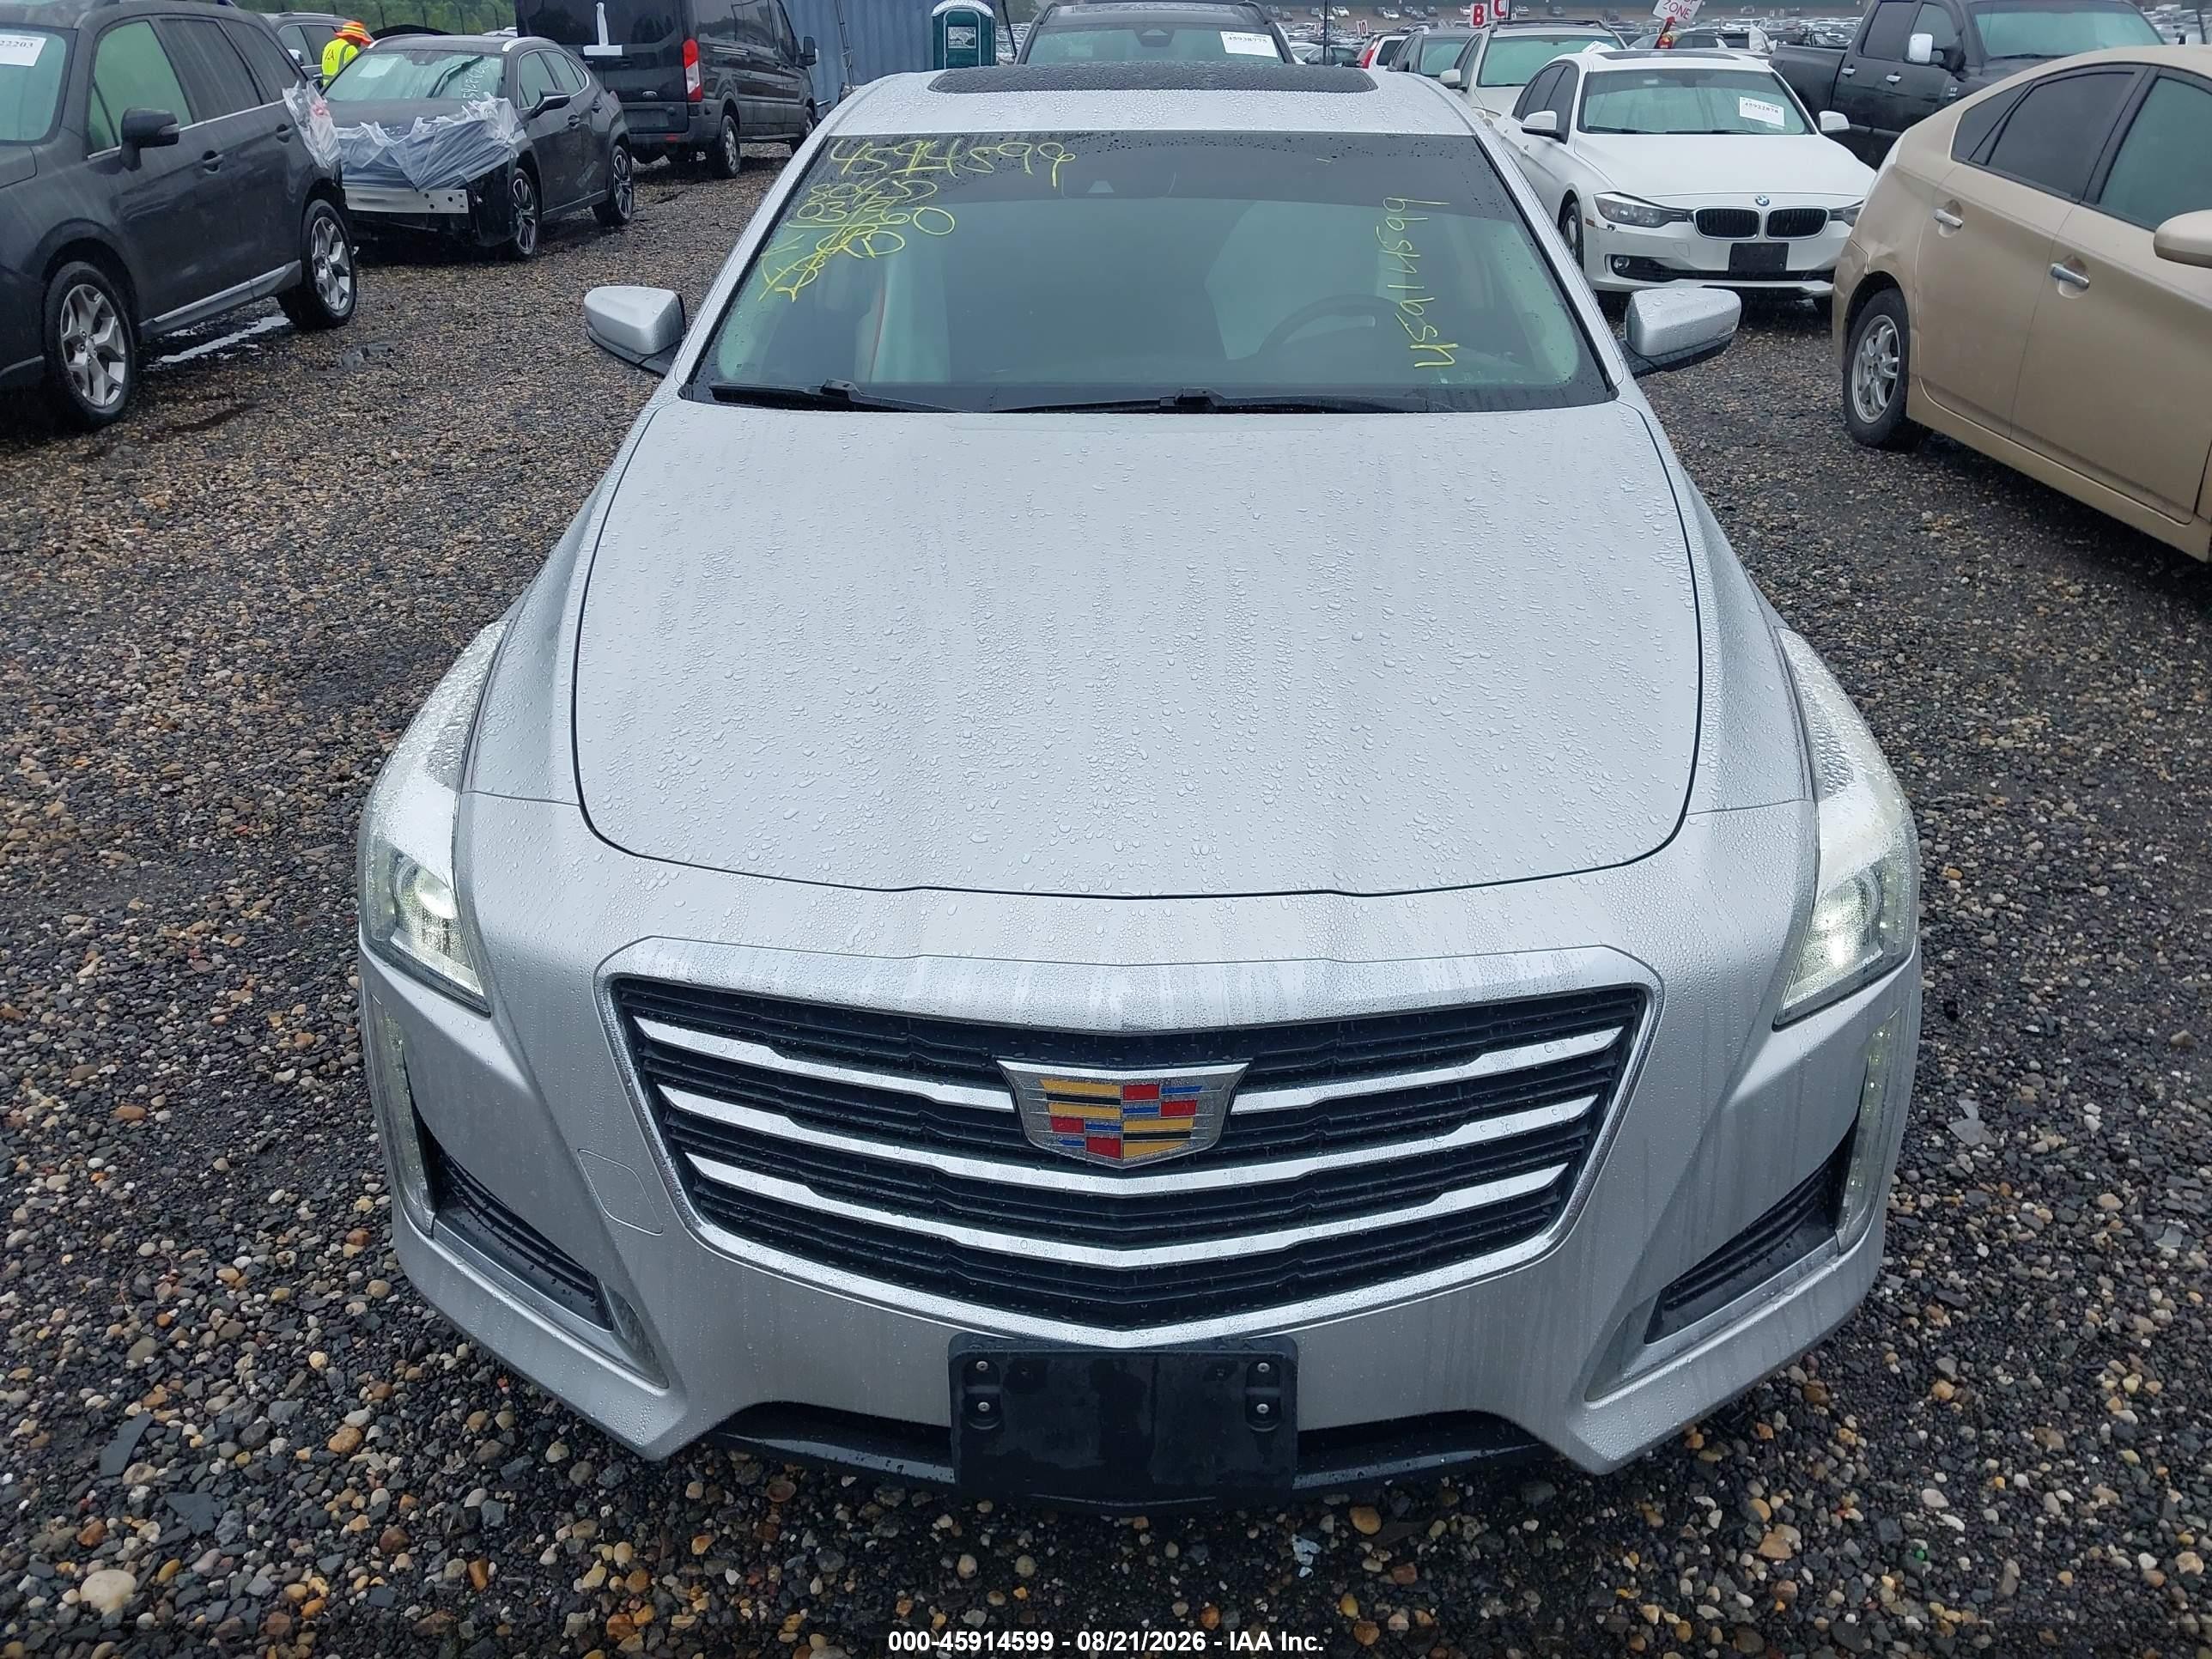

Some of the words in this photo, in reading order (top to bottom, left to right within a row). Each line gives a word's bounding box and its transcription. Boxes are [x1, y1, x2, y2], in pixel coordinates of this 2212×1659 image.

[1473, 5, 1485, 26] B
[1494, 0, 1507, 16] C
[1662, 0, 1692, 20] ZONE
[1358, 21, 1367, 35] 10
[830, 138, 1076, 188] 45914599
[1376, 197, 1459, 368] 45914599
